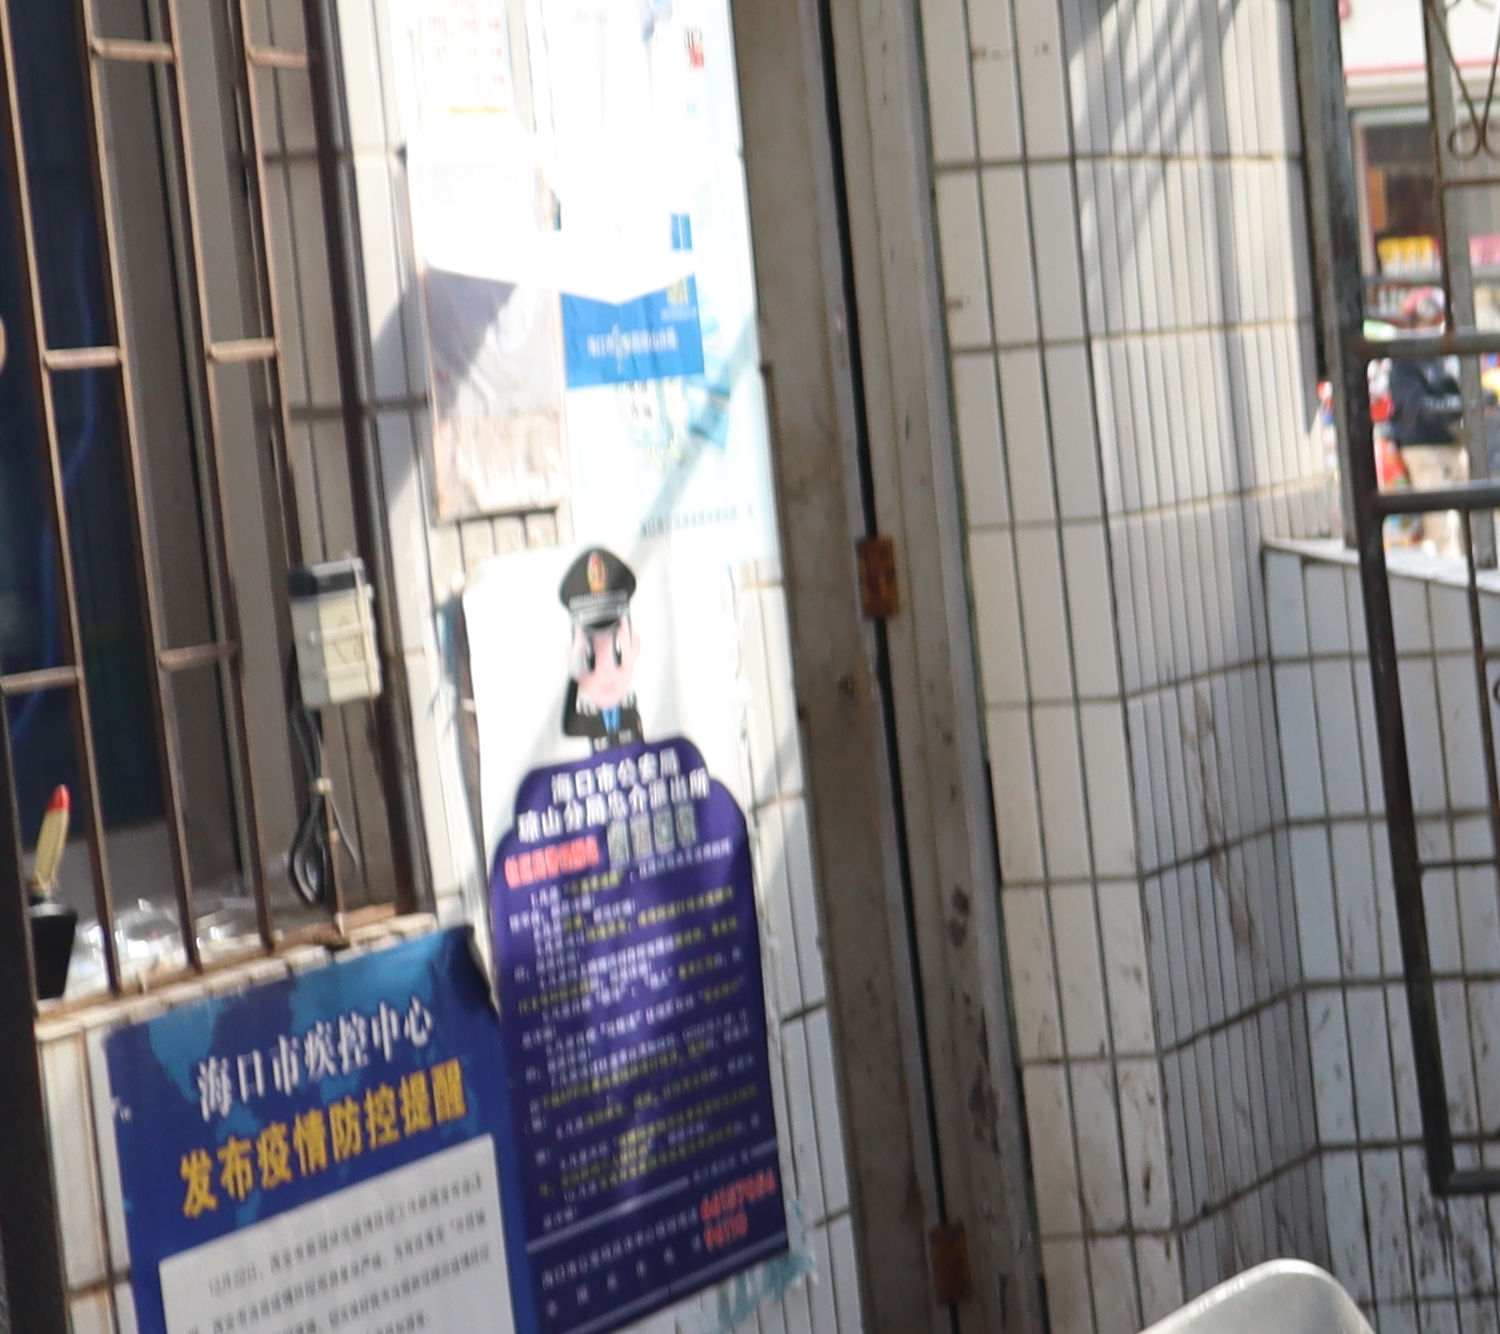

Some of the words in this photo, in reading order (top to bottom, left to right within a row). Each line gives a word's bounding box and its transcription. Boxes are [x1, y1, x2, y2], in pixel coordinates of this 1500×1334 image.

[197, 995, 433, 1123] 海口市疾控中心
[180, 1058, 468, 1218] 发布疫情防控提醒
